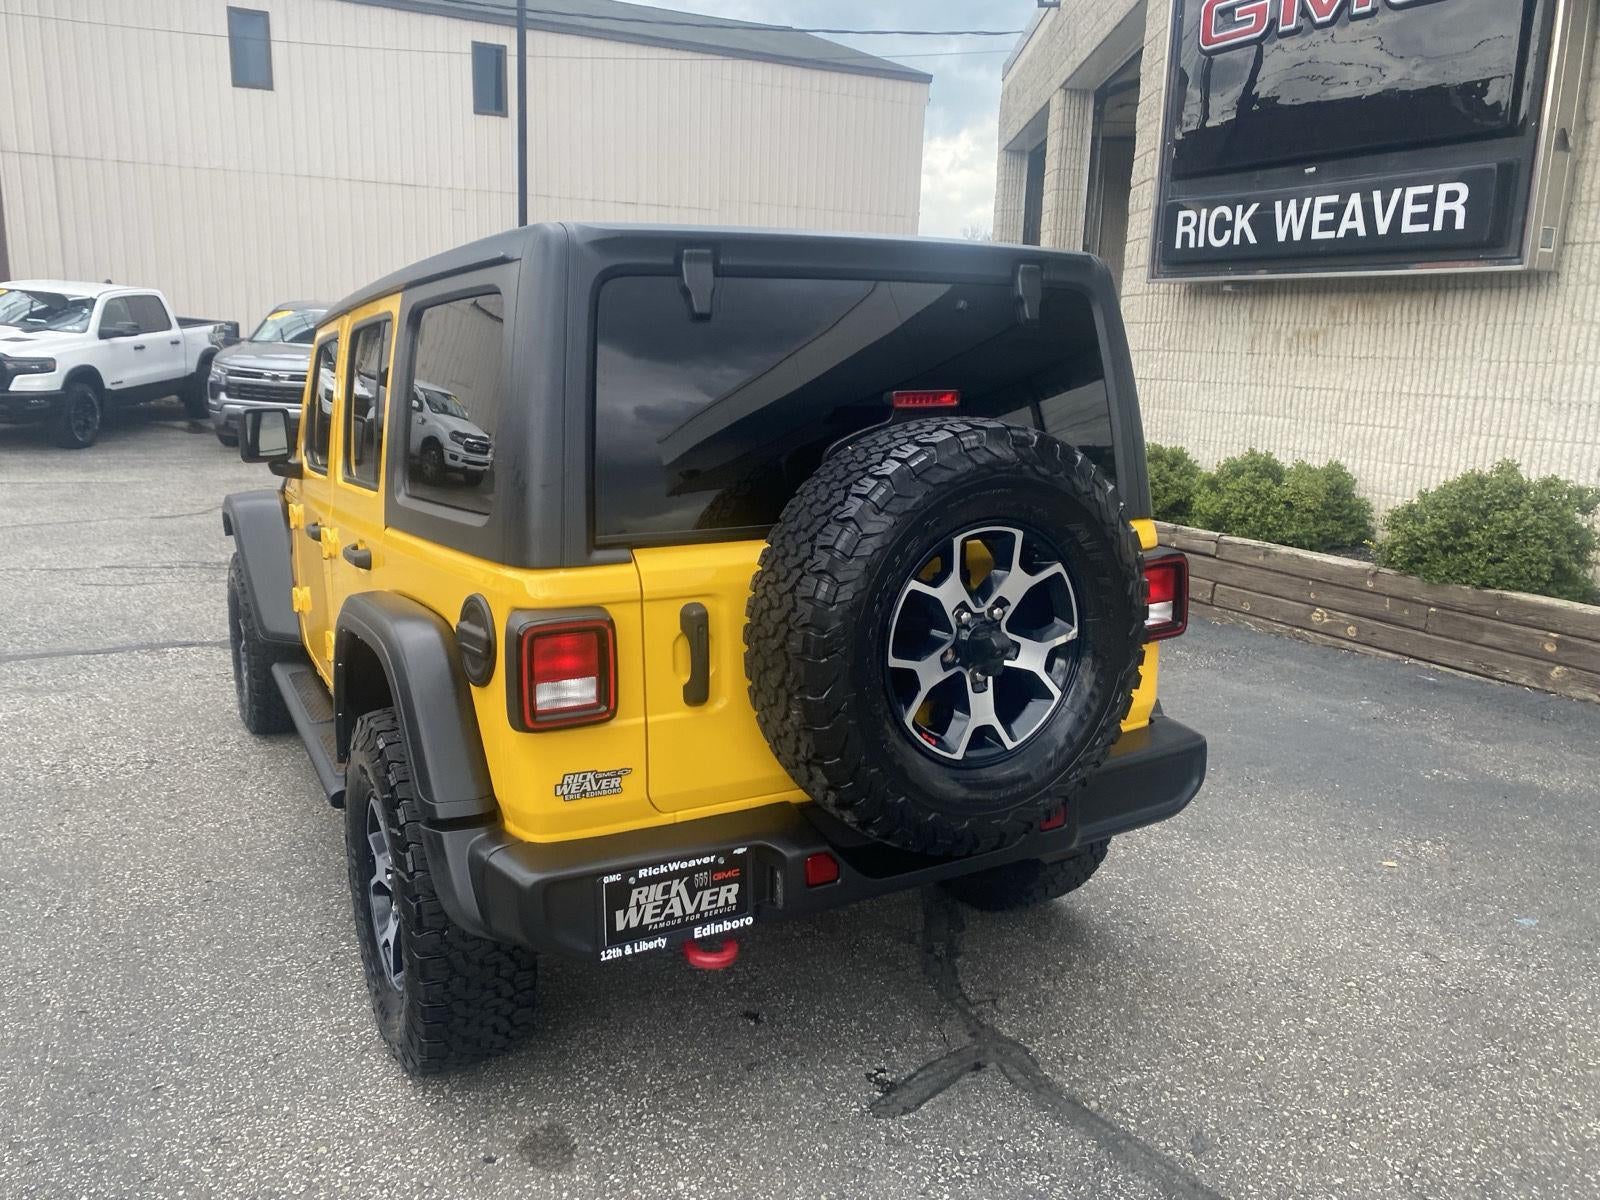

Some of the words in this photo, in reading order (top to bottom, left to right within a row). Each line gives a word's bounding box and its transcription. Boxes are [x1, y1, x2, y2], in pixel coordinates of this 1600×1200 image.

[1174, 202, 1260, 249] RICK
[1274, 181, 1470, 242] WEAVER
[556, 777, 622, 796] WEAVER
[563, 771, 597, 785] RICK
[595, 771, 617, 779] GMC
[564, 793, 582, 801] ERIE
[585, 787, 622, 798] EDINBORO
[603, 873, 622, 884] GMC
[638, 855, 716, 879] RickWeaver
[713, 868, 741, 881] GMC
[628, 876, 690, 908] RICK
[615, 883, 740, 932] WEAVER
[648, 918, 682, 931] FAMOUS
[685, 914, 701, 922] FOR
[704, 905, 737, 918] SERVICE
[693, 916, 754, 939] Edinboro
[600, 947, 623, 962] 12th
[624, 944, 633, 955] &
[634, 937, 667, 953] Liberty
